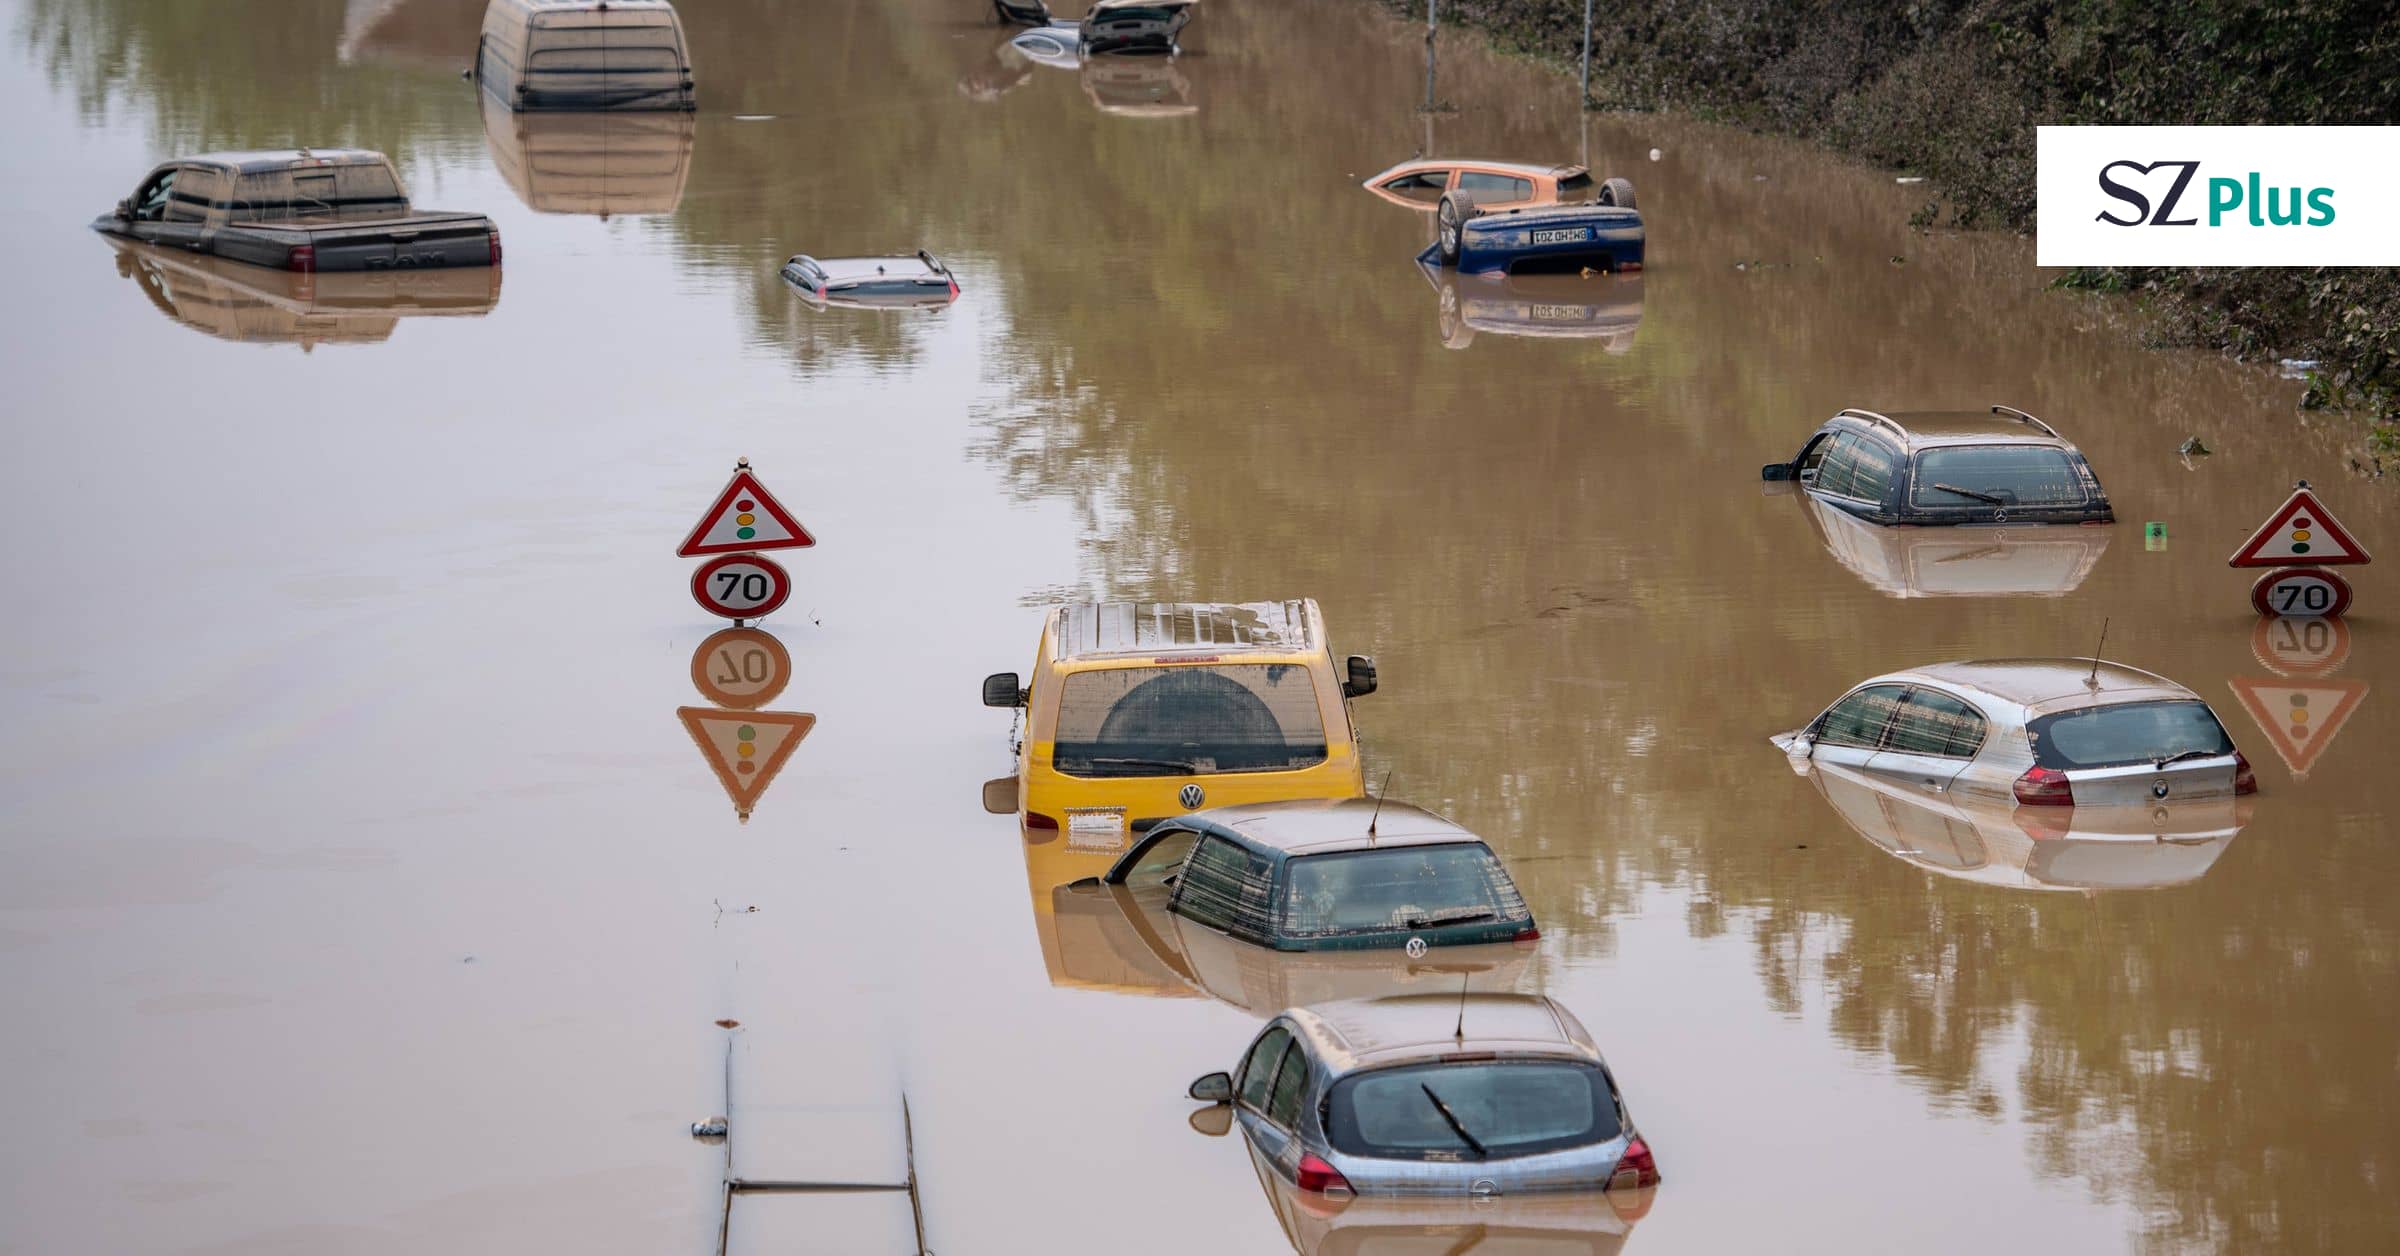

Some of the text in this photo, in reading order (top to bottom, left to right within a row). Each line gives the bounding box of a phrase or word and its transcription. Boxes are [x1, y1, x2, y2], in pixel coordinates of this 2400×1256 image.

[1534, 232, 1553, 243] 201
[717, 573, 768, 602] 70
[2276, 584, 2329, 611] 70
